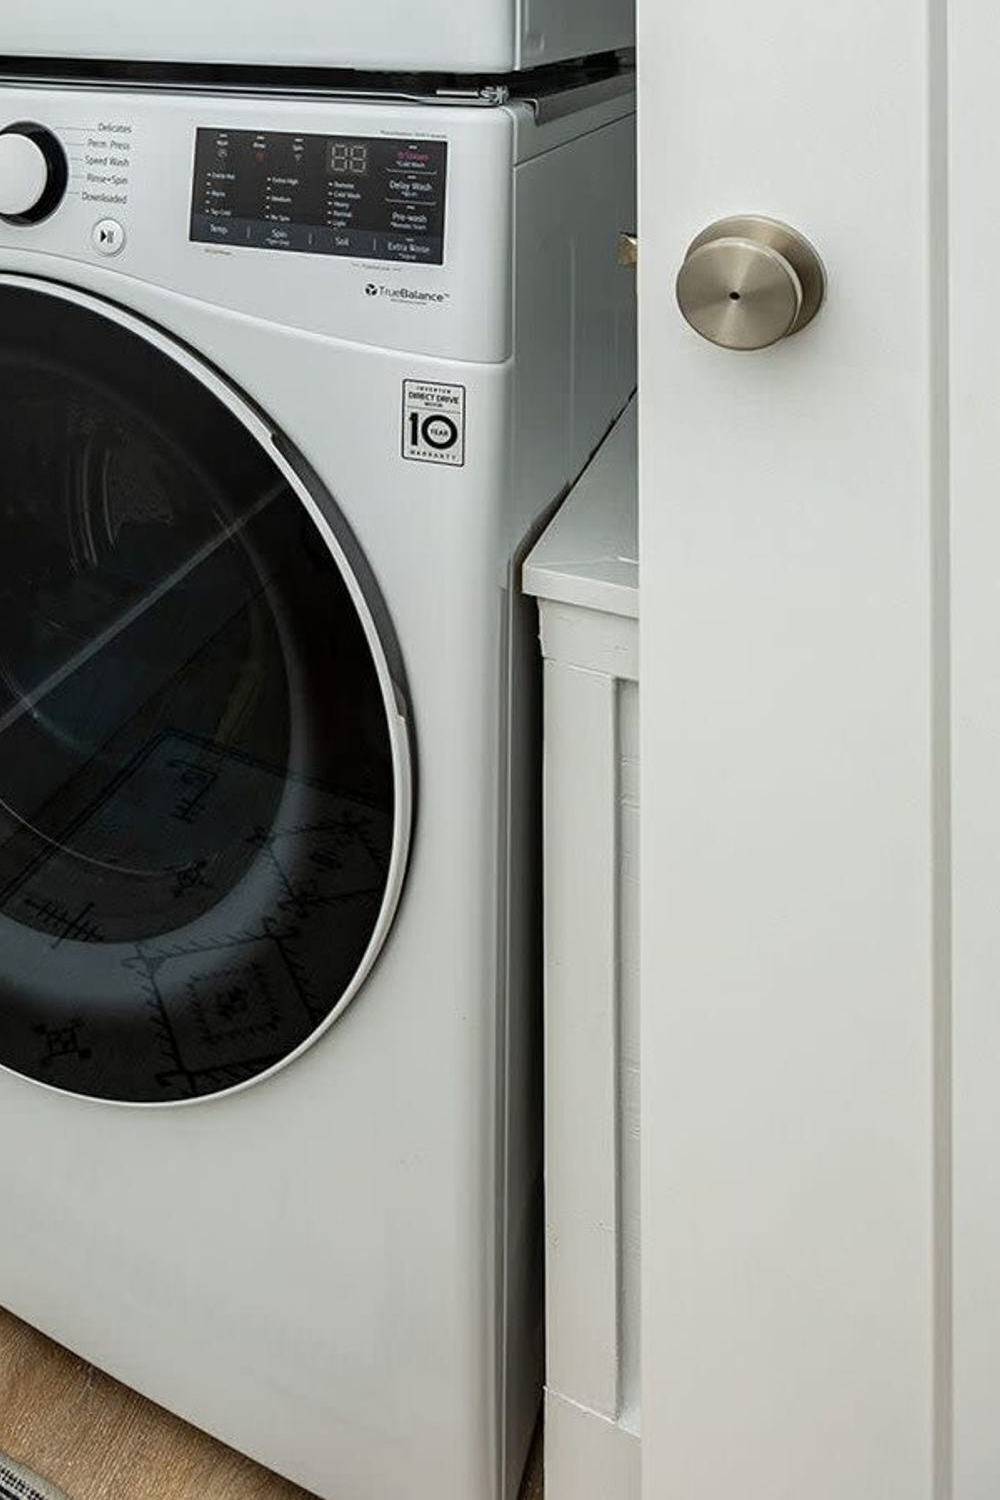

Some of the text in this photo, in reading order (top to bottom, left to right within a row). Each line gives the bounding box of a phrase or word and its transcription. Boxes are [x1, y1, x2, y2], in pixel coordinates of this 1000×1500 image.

[98, 122, 133, 133] Delicates
[110, 140, 130, 150] Press
[85, 155, 129, 167] Speed Wash
[389, 179, 432, 192] Delay Wash
[81, 191, 127, 205] Downloaded
[335, 237, 349, 246] Soil
[387, 242, 408, 252] Extra
[408, 391, 459, 405] DIRECT DRIVE
[409, 412, 458, 450] 10
[430, 428, 449, 436] YEAR
